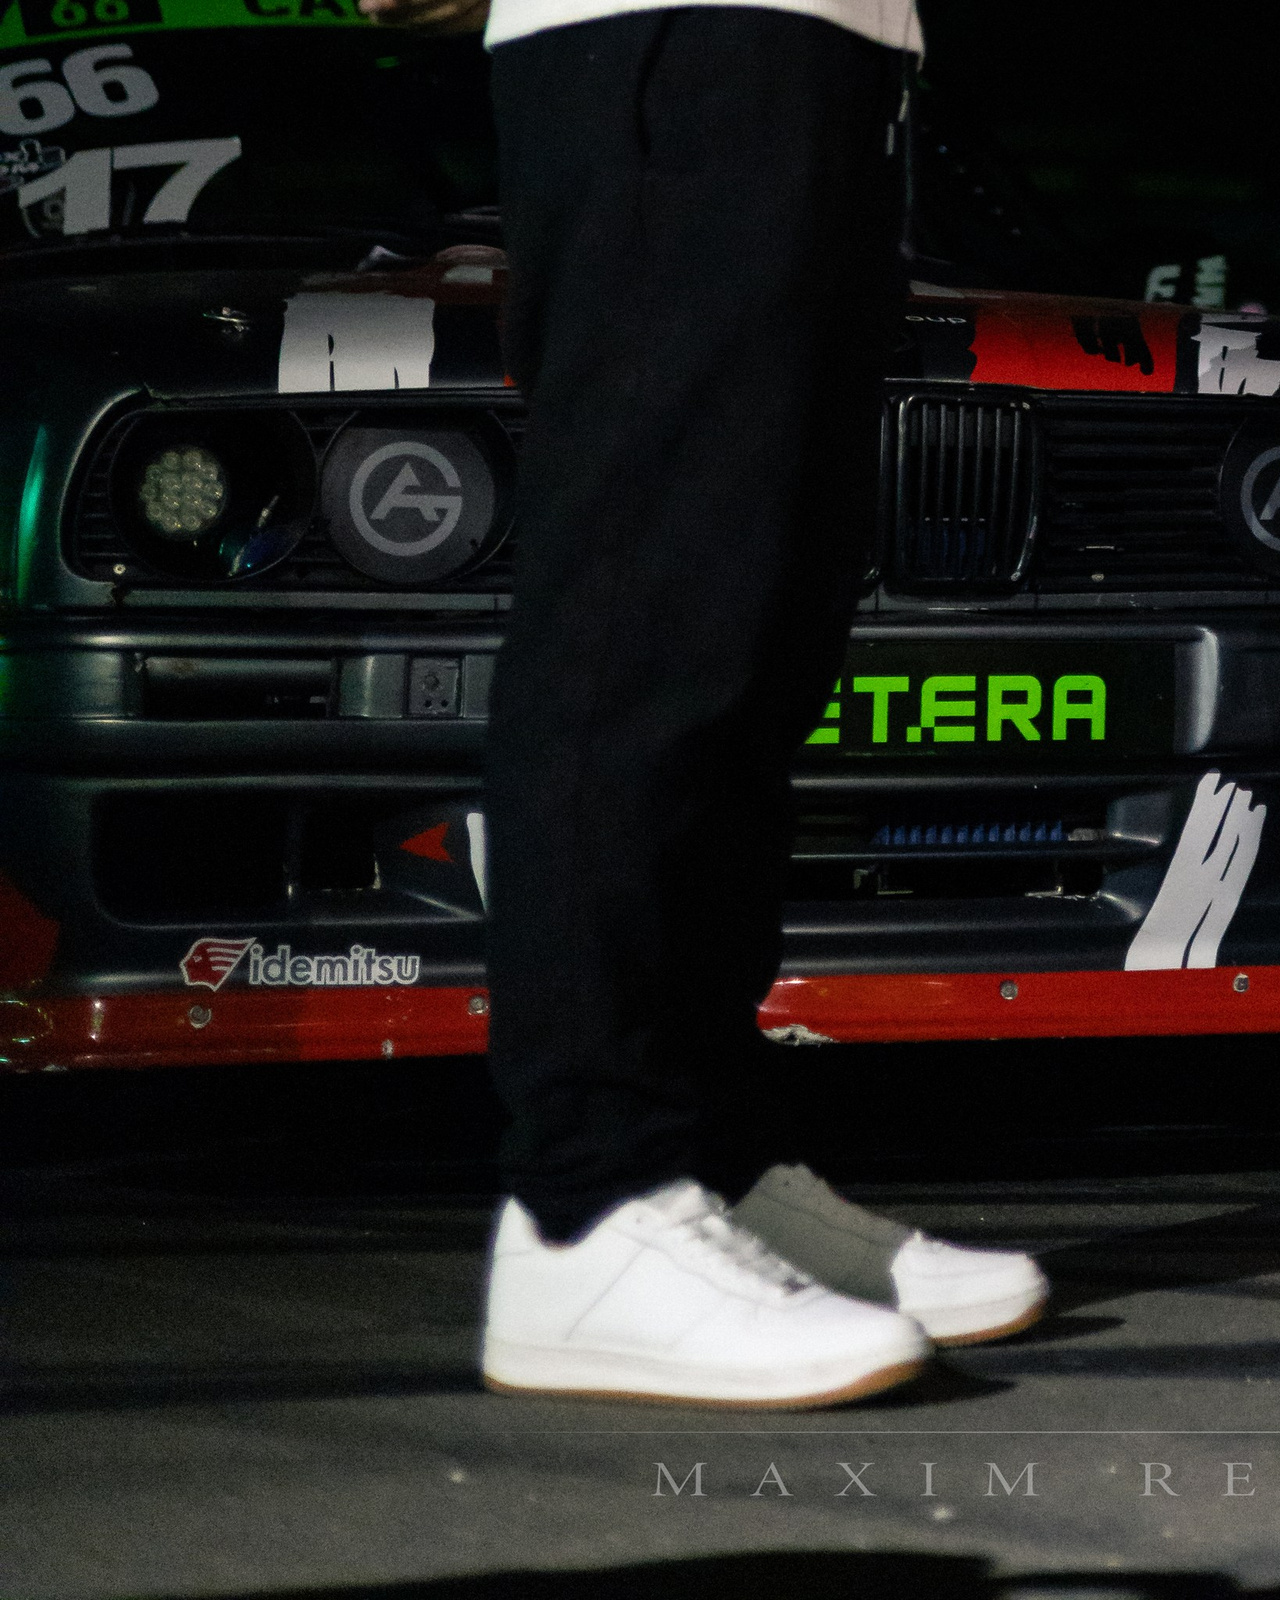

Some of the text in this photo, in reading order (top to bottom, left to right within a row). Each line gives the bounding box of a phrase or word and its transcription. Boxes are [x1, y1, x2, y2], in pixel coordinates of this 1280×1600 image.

[0, 42, 159, 136] 66
[18, 135, 242, 236] 17
[249, 943, 420, 985] idemitsu
